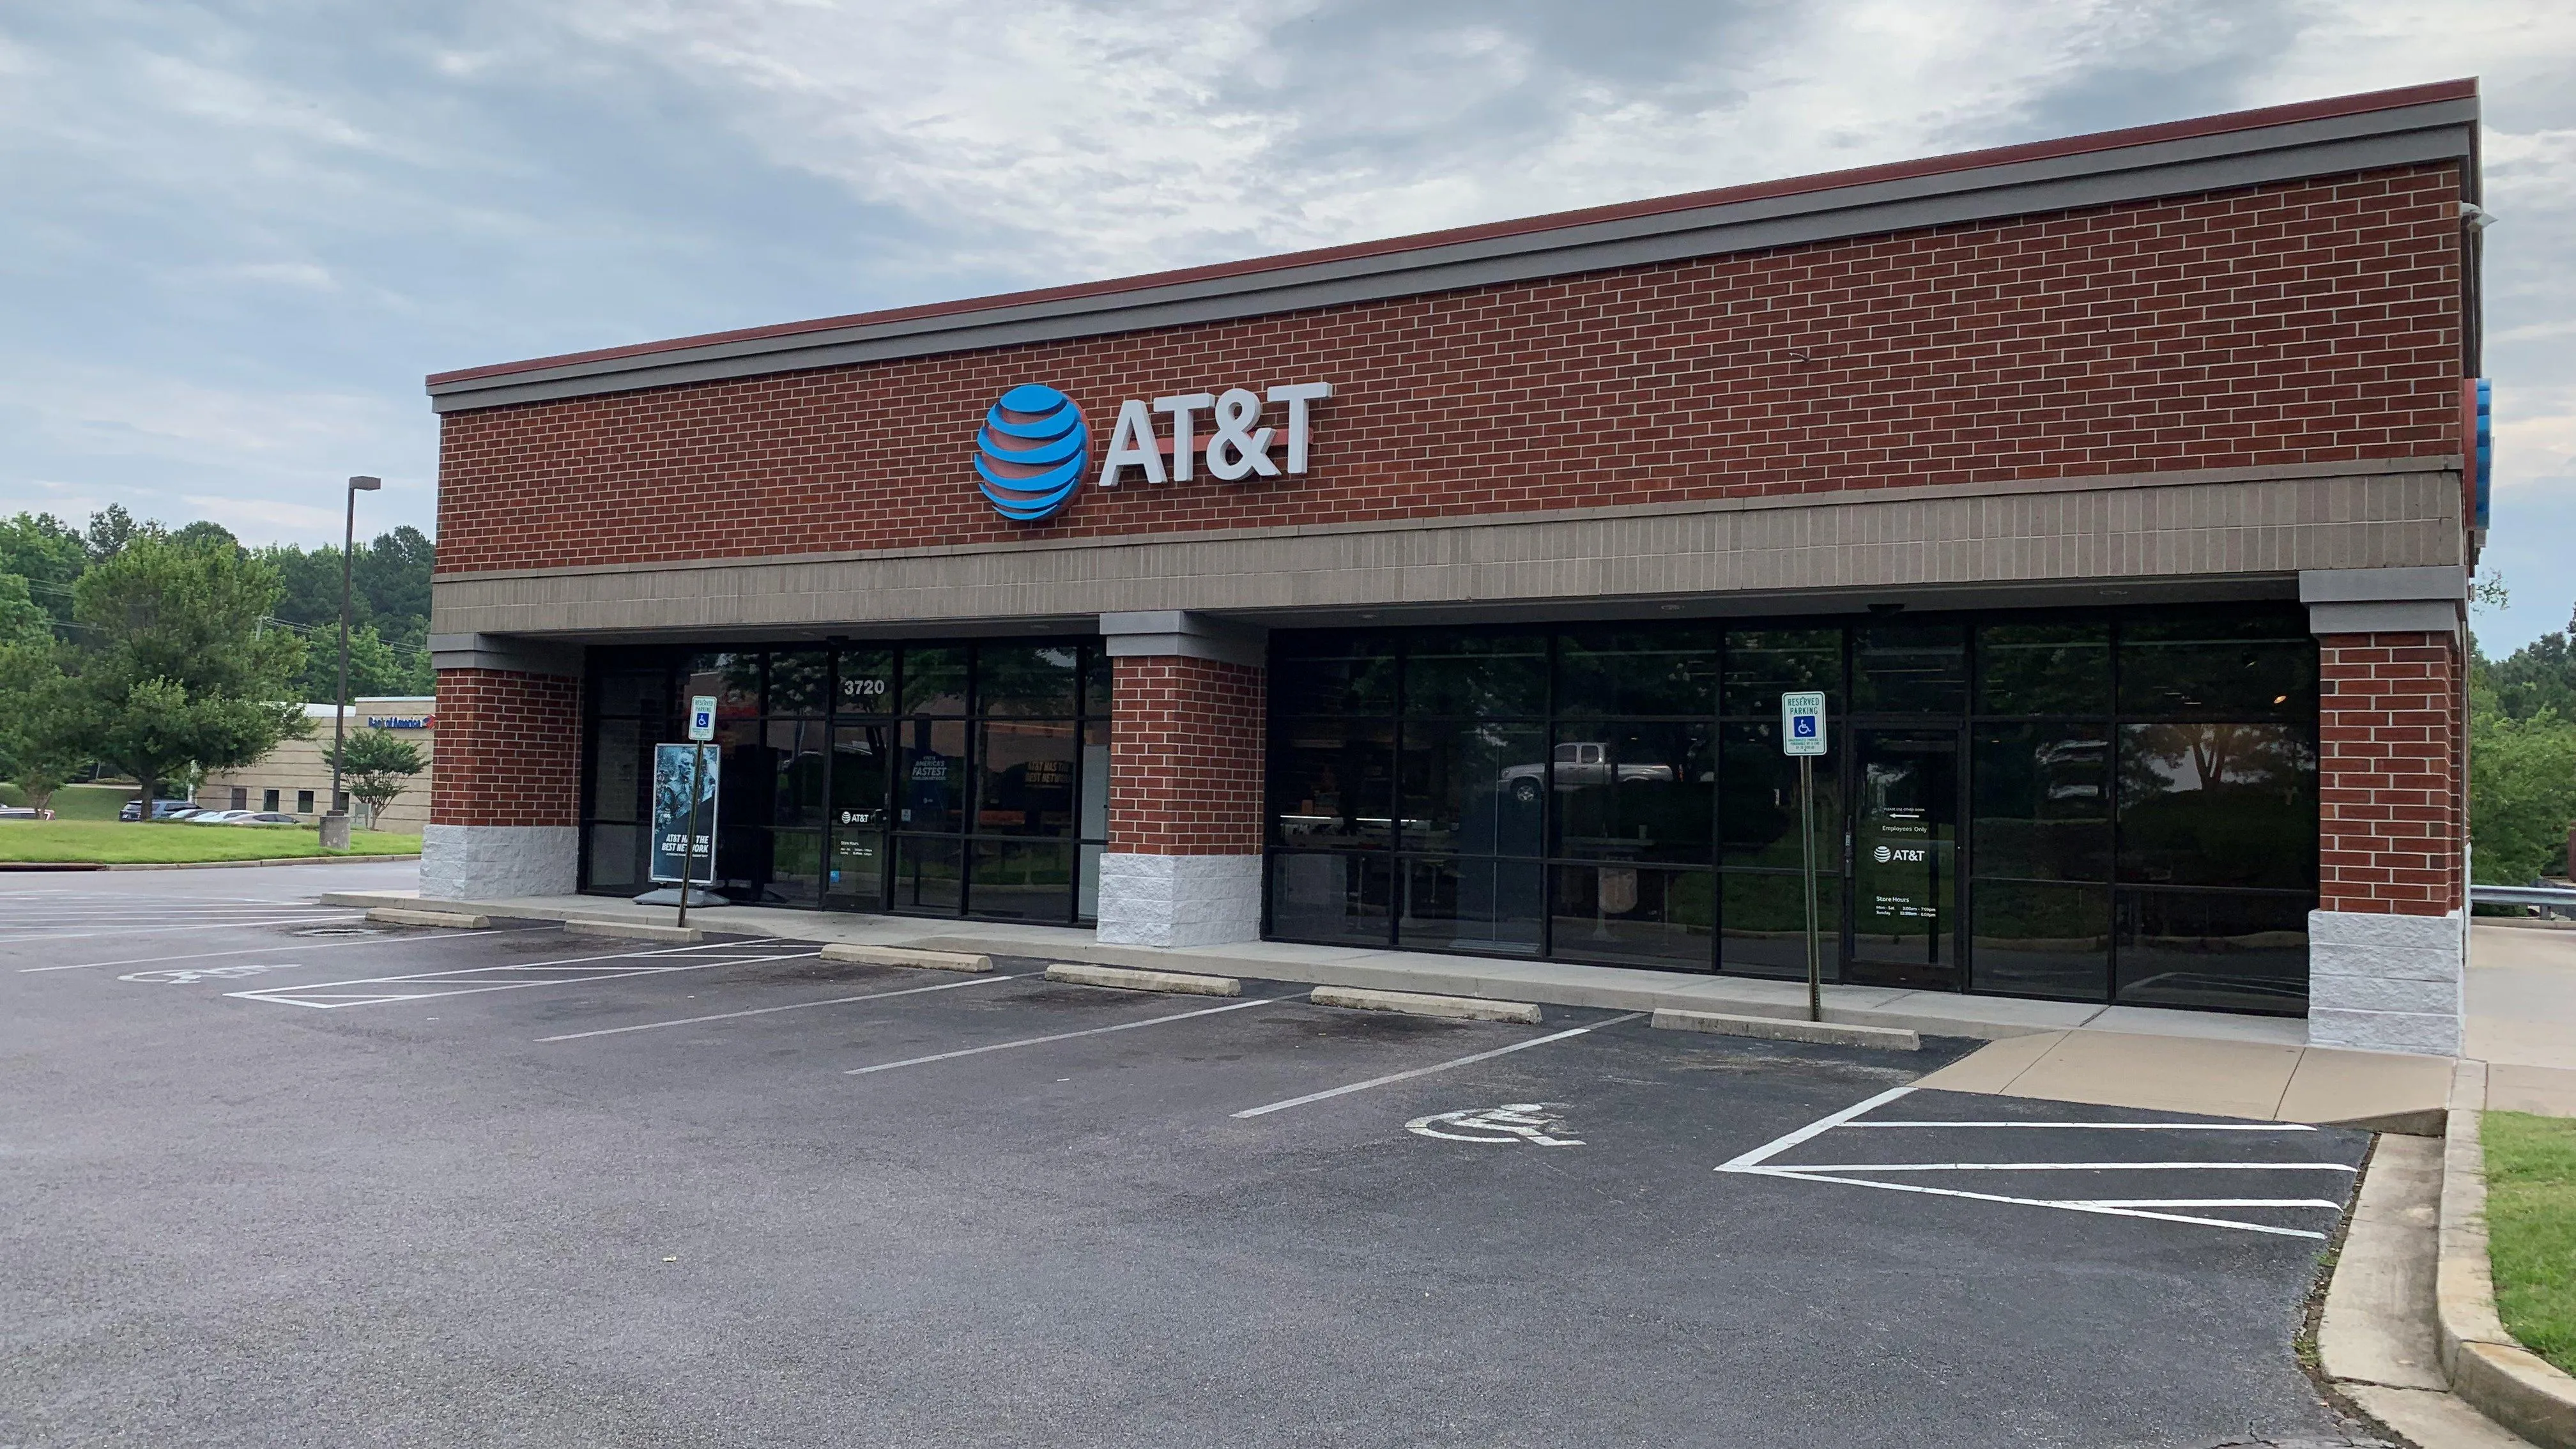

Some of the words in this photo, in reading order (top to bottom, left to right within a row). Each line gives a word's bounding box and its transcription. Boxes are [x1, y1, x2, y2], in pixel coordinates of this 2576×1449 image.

[1098, 381, 1333, 487] AT&T
[844, 680, 885, 695] 3720
[1788, 698, 1820, 706] RESERVED
[1790, 707, 1818, 715] PARKING
[912, 767, 947, 776] FASTEST
[851, 814, 869, 823] AT&T
[666, 834, 682, 843] AT&T
[696, 835, 709, 844] THE
[661, 843, 677, 852] BEST
[676, 843, 709, 854] NEORK
[1892, 849, 1926, 862] AT&T
